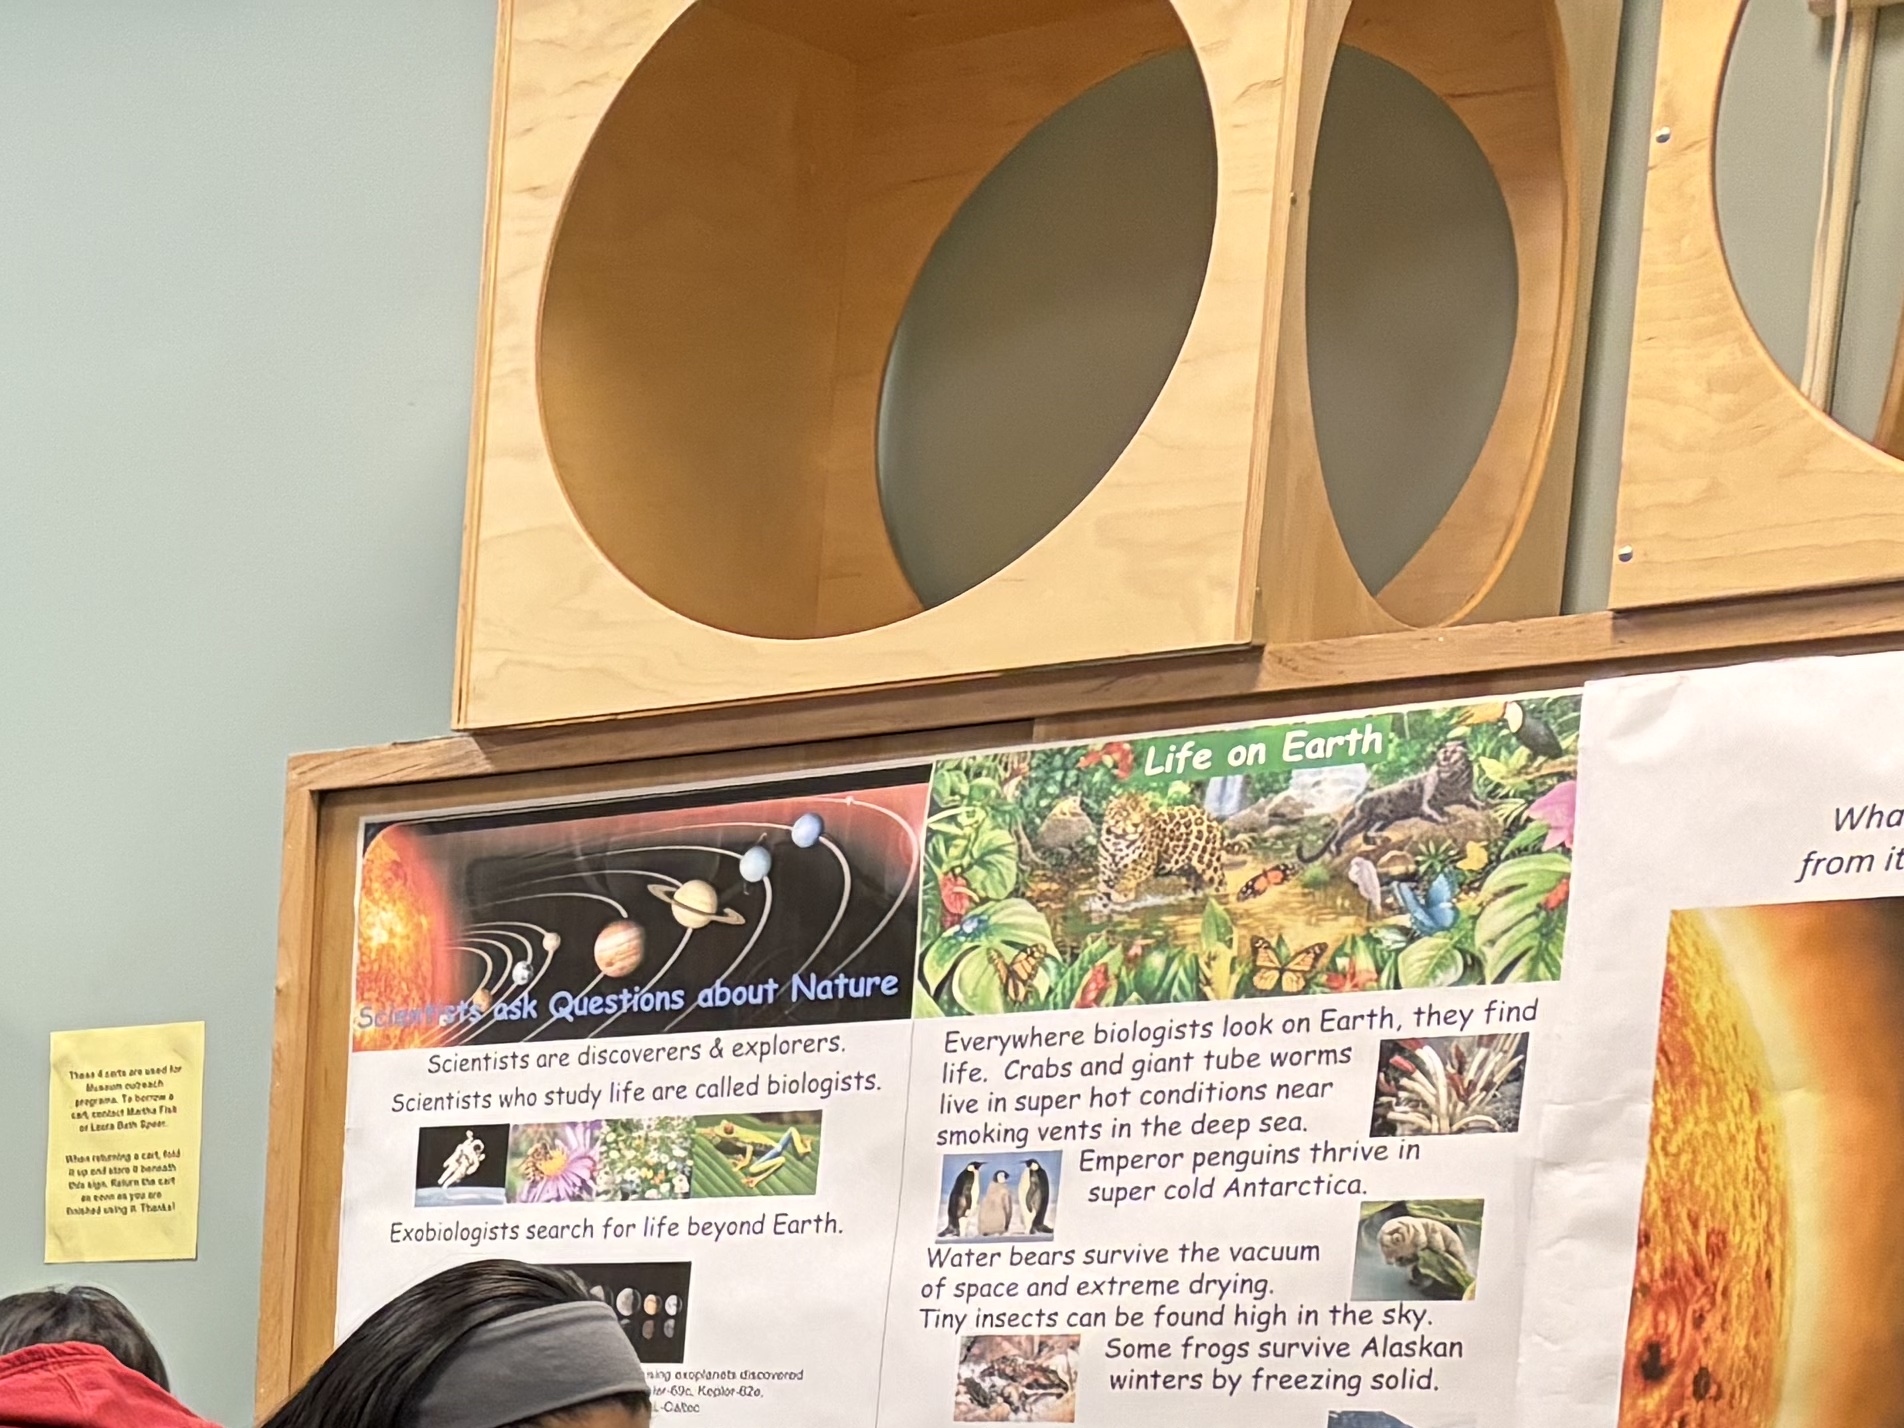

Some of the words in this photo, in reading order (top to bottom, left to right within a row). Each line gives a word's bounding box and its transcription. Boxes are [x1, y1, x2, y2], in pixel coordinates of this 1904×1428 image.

[1144, 739, 1213, 777] Life
[1227, 742, 1267, 767] on
[1282, 723, 1384, 763] Earth
[1793, 850, 1875, 884] from
[357, 997, 484, 1030] Scientists
[493, 993, 538, 1022] ask
[549, 984, 685, 1023] Questions
[697, 978, 780, 1009] about
[791, 972, 900, 1003] Nature
[944, 1025, 1085, 1057] Everywhere
[1093, 1018, 1214, 1049] biologists
[1222, 1012, 1274, 1038] look
[1281, 1016, 1311, 1035] on
[1319, 1005, 1402, 1033] Earth,
[1412, 1002, 1475, 1033] they
[1483, 997, 1539, 1025] find
[427, 1051, 530, 1075] Scientists
[536, 1052, 570, 1069] are
[577, 1043, 702, 1067] discoverers
[708, 1036, 724, 1059] &
[731, 1033, 846, 1064] explorers.
[942, 1060, 988, 1085] life.
[1004, 1056, 1073, 1081] Crabs
[1080, 1051, 1125, 1077] and
[1130, 1051, 1195, 1082] giant
[1203, 1046, 1261, 1072] tube
[1270, 1046, 1353, 1068] worms
[391, 1090, 492, 1113] Scientists
[498, 1086, 538, 1109] who
[543, 1082, 602, 1111] study
[609, 1080, 646, 1104] life
[651, 1084, 688, 1102] are
[695, 1073, 760, 1100] called
[767, 1070, 882, 1100] biologists.
[939, 1092, 979, 1115] live
[987, 1091, 1007, 1113] in
[1014, 1093, 1082, 1118] super
[1089, 1085, 1132, 1109] hot
[1139, 1080, 1268, 1106] conditions
[1275, 1081, 1334, 1100] near
[936, 1121, 1029, 1150] smoking
[1037, 1119, 1103, 1142] vents
[1111, 1117, 1132, 1139] in
[1140, 1114, 1183, 1138] the
[1190, 1111, 1251, 1141] deep
[1258, 1115, 1308, 1133] sea.
[1079, 1148, 1185, 1177] Emperor
[1191, 1143, 1301, 1175] penguins
[1309, 1139, 1389, 1164] thrive
[1398, 1138, 1420, 1161] in
[1087, 1184, 1156, 1209] super
[1163, 1176, 1216, 1201] cold
[1222, 1173, 1367, 1199] Antarctica.
[389, 1220, 520, 1248] Exobiologists
[525, 1217, 594, 1240] search
[602, 1216, 637, 1240] for
[643, 1215, 680, 1239] life
[687, 1212, 766, 1243] beyond
[772, 1211, 844, 1236] Earth.
[927, 1246, 1002, 1269] Water
[1009, 1244, 1076, 1267] bears
[1082, 1242, 1169, 1266] survive
[1178, 1240, 1220, 1264] the
[1229, 1244, 1320, 1263] vacuum
[920, 1275, 948, 1300] of
[952, 1281, 1019, 1305] space
[1026, 1274, 1070, 1298] and
[1076, 1275, 1180, 1297] extreme
[1188, 1271, 1274, 1301] drying.
[918, 1309, 966, 1336] Tiny
[975, 1307, 1059, 1329] insects
[1066, 1311, 1106, 1328] can
[1114, 1304, 1145, 1328] be
[1153, 1303, 1226, 1329] found
[1233, 1302, 1287, 1333] high
[1297, 1303, 1319, 1327] in
[1328, 1301, 1374, 1327] the
[1381, 1299, 1434, 1328] sky.
[1104, 1337, 1172, 1360] Some
[1180, 1335, 1250, 1366] frogs
[1257, 1335, 1351, 1359] survive
[1360, 1333, 1463, 1359] Alaskan
[1109, 1368, 1204, 1391] winters
[1212, 1367, 1243, 1397] by
[1251, 1366, 1362, 1397] freezing
[1370, 1366, 1439, 1392] solid.
